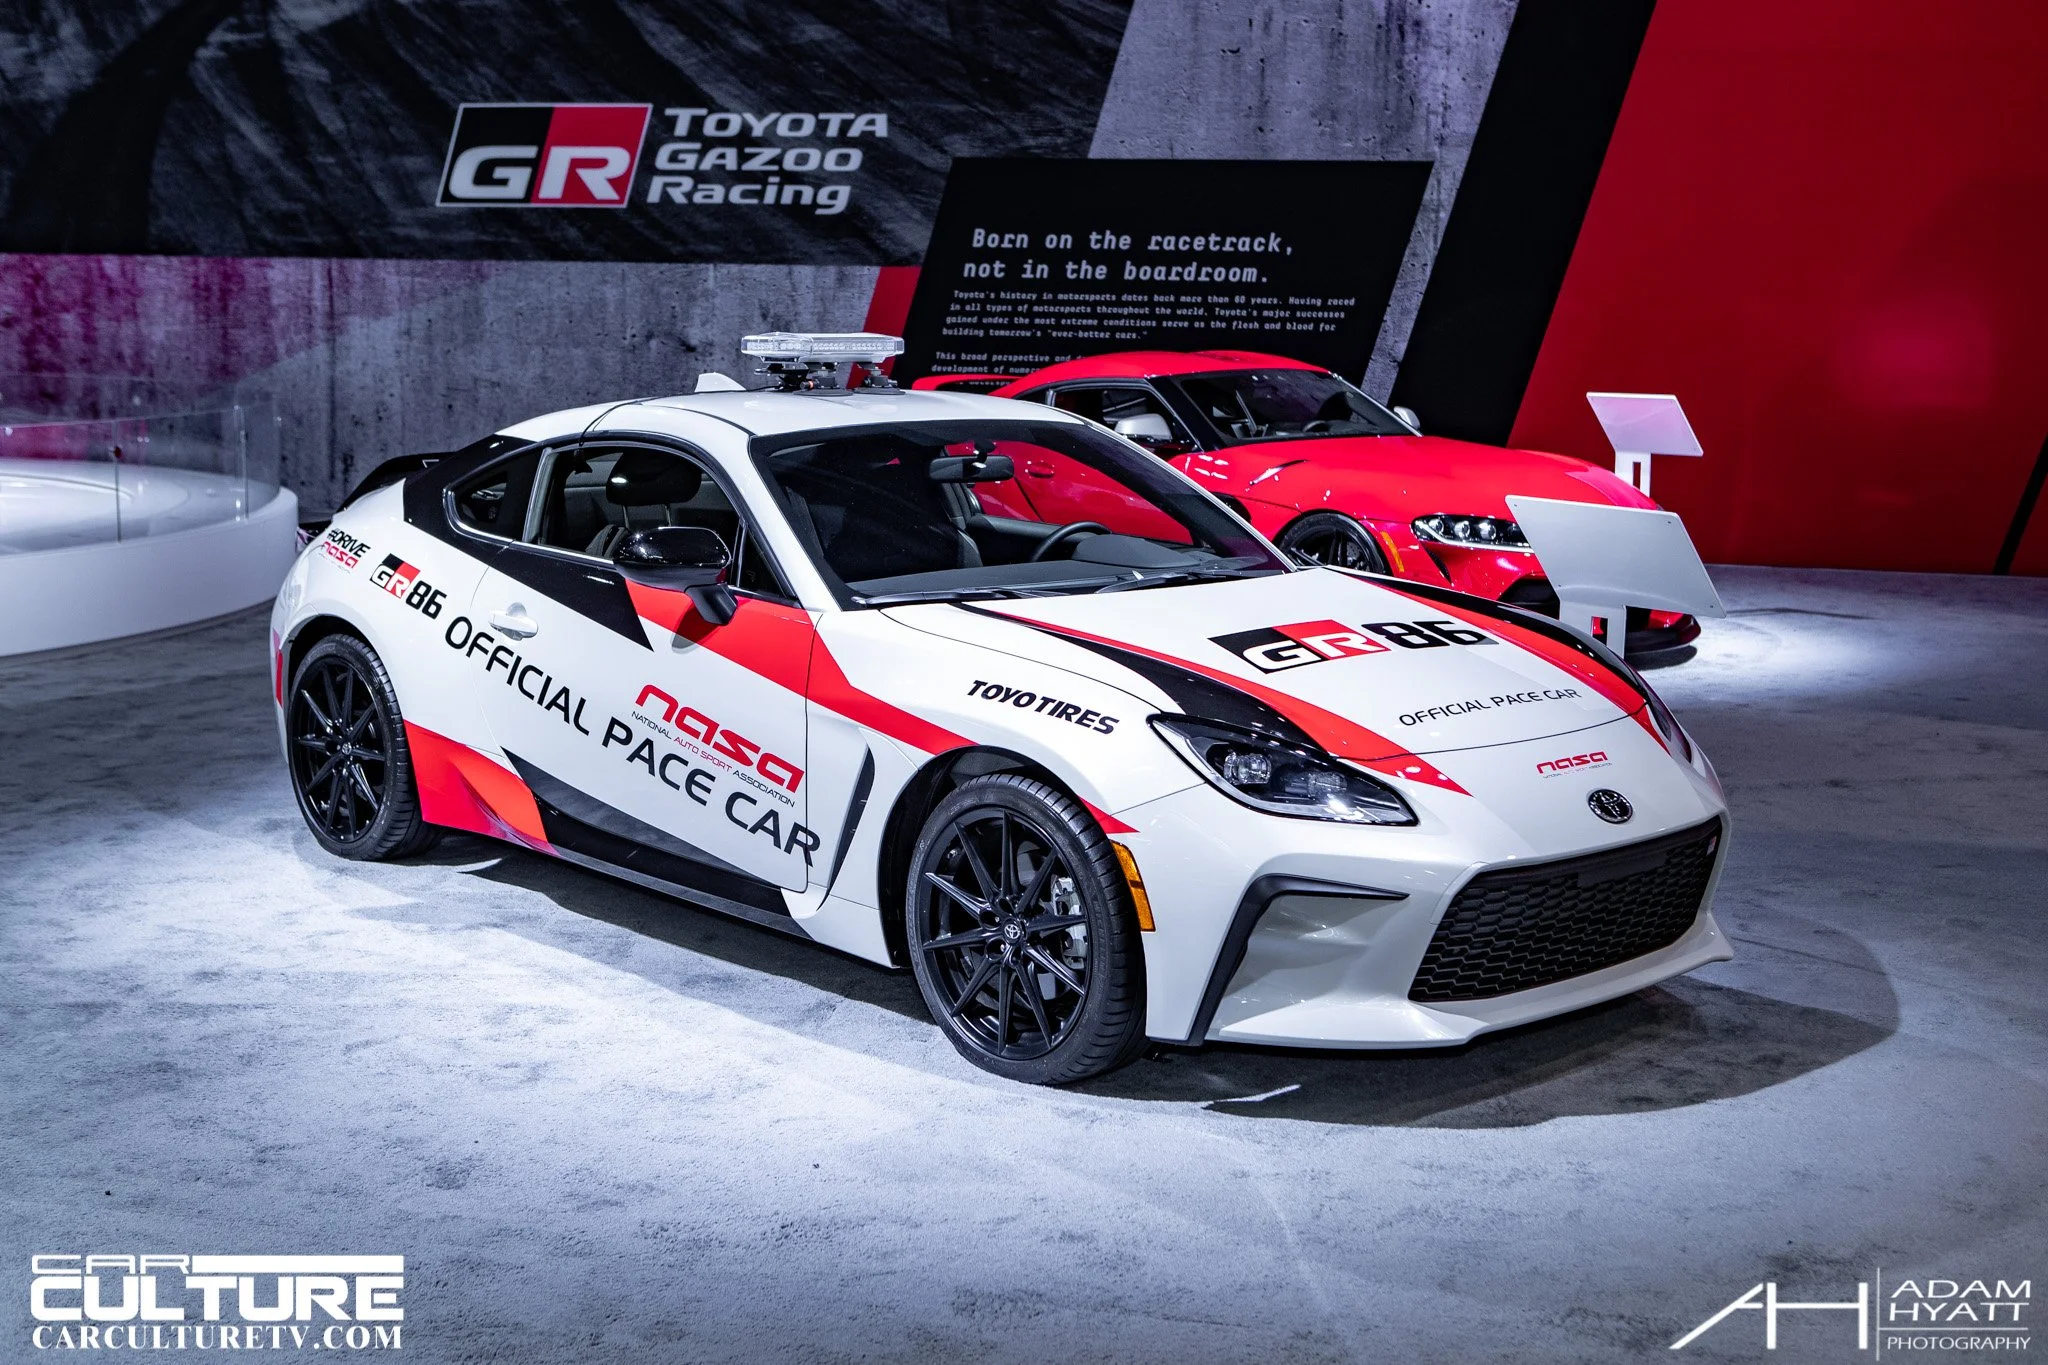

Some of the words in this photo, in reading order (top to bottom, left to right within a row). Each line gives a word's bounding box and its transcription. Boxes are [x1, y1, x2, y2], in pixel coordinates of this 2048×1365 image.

[664, 107, 888, 138] TOYOTA
[654, 142, 863, 172] GAZOO
[448, 145, 632, 201] GR
[646, 175, 851, 216] Racing
[973, 228, 1028, 248] Born
[1045, 234, 1072, 249] on
[1089, 229, 1132, 250] the
[1148, 232, 1292, 255] racetrack,
[963, 260, 1006, 278] not
[1021, 259, 1049, 279] in
[1066, 260, 1108, 279] the
[1124, 261, 1267, 282] boardroom.
[950, 303, 961, 311] in
[986, 304, 1012, 313] types
[1017, 304, 1028, 313] of
[1033, 305, 1091, 314] motorsports
[1097, 306, 1150, 315] throughout
[1155, 307, 1171, 315] the
[1215, 308, 1258, 317] Toyota's
[1263, 309, 1291, 318] major
[954, 290, 995, 299] Toyota's
[1000, 291, 1037, 301] history
[1042, 292, 1053, 300] in
[1058, 293, 1116, 302] motorsports
[1121, 294, 1148, 302] dates
[1153, 294, 1175, 303] back
[1208, 295, 1229, 303] than
[1251, 297, 1283, 306] years.
[1289, 297, 1321, 307] Having
[1327, 297, 1355, 306] raced
[943, 328, 984, 337] building
[989, 329, 1041, 337] tomorrow's
[946, 316, 977, 324] gained
[1014, 317, 1030, 325] the
[1034, 317, 1055, 325] most
[1061, 318, 1098, 326] extreme
[1103, 318, 1157, 327] conditions
[1211, 321, 1227, 329] the
[1232, 321, 1259, 330] flesh
[1264, 322, 1281, 330] and
[1286, 322, 1313, 330] blood
[1319, 323, 1336, 332] for
[931, 364, 988, 373] development
[994, 365, 1004, 374] of
[935, 352, 956, 360] This
[992, 353, 1049, 362] perspective
[326, 529, 371, 558] #DRIVE
[371, 563, 412, 598] GR
[405, 580, 447, 620] 86
[1242, 632, 1390, 670] GR
[967, 679, 1038, 708] TOYO
[1034, 696, 1120, 734] TIRES
[1399, 699, 1491, 726] OFFICIAL
[1490, 691, 1544, 707] PACE
[1542, 688, 1582, 700] CAR
[444, 615, 590, 737] OFFICIAL
[601, 716, 716, 807] PACE
[724, 791, 821, 868] CAR
[635, 684, 805, 794] nasa
[631, 710, 672, 740] NATIONAL
[673, 736, 699, 755] AUTO
[700, 750, 733, 773] SPORT
[732, 769, 796, 809] ASSOCIATION
[1536, 751, 1609, 774] nasa
